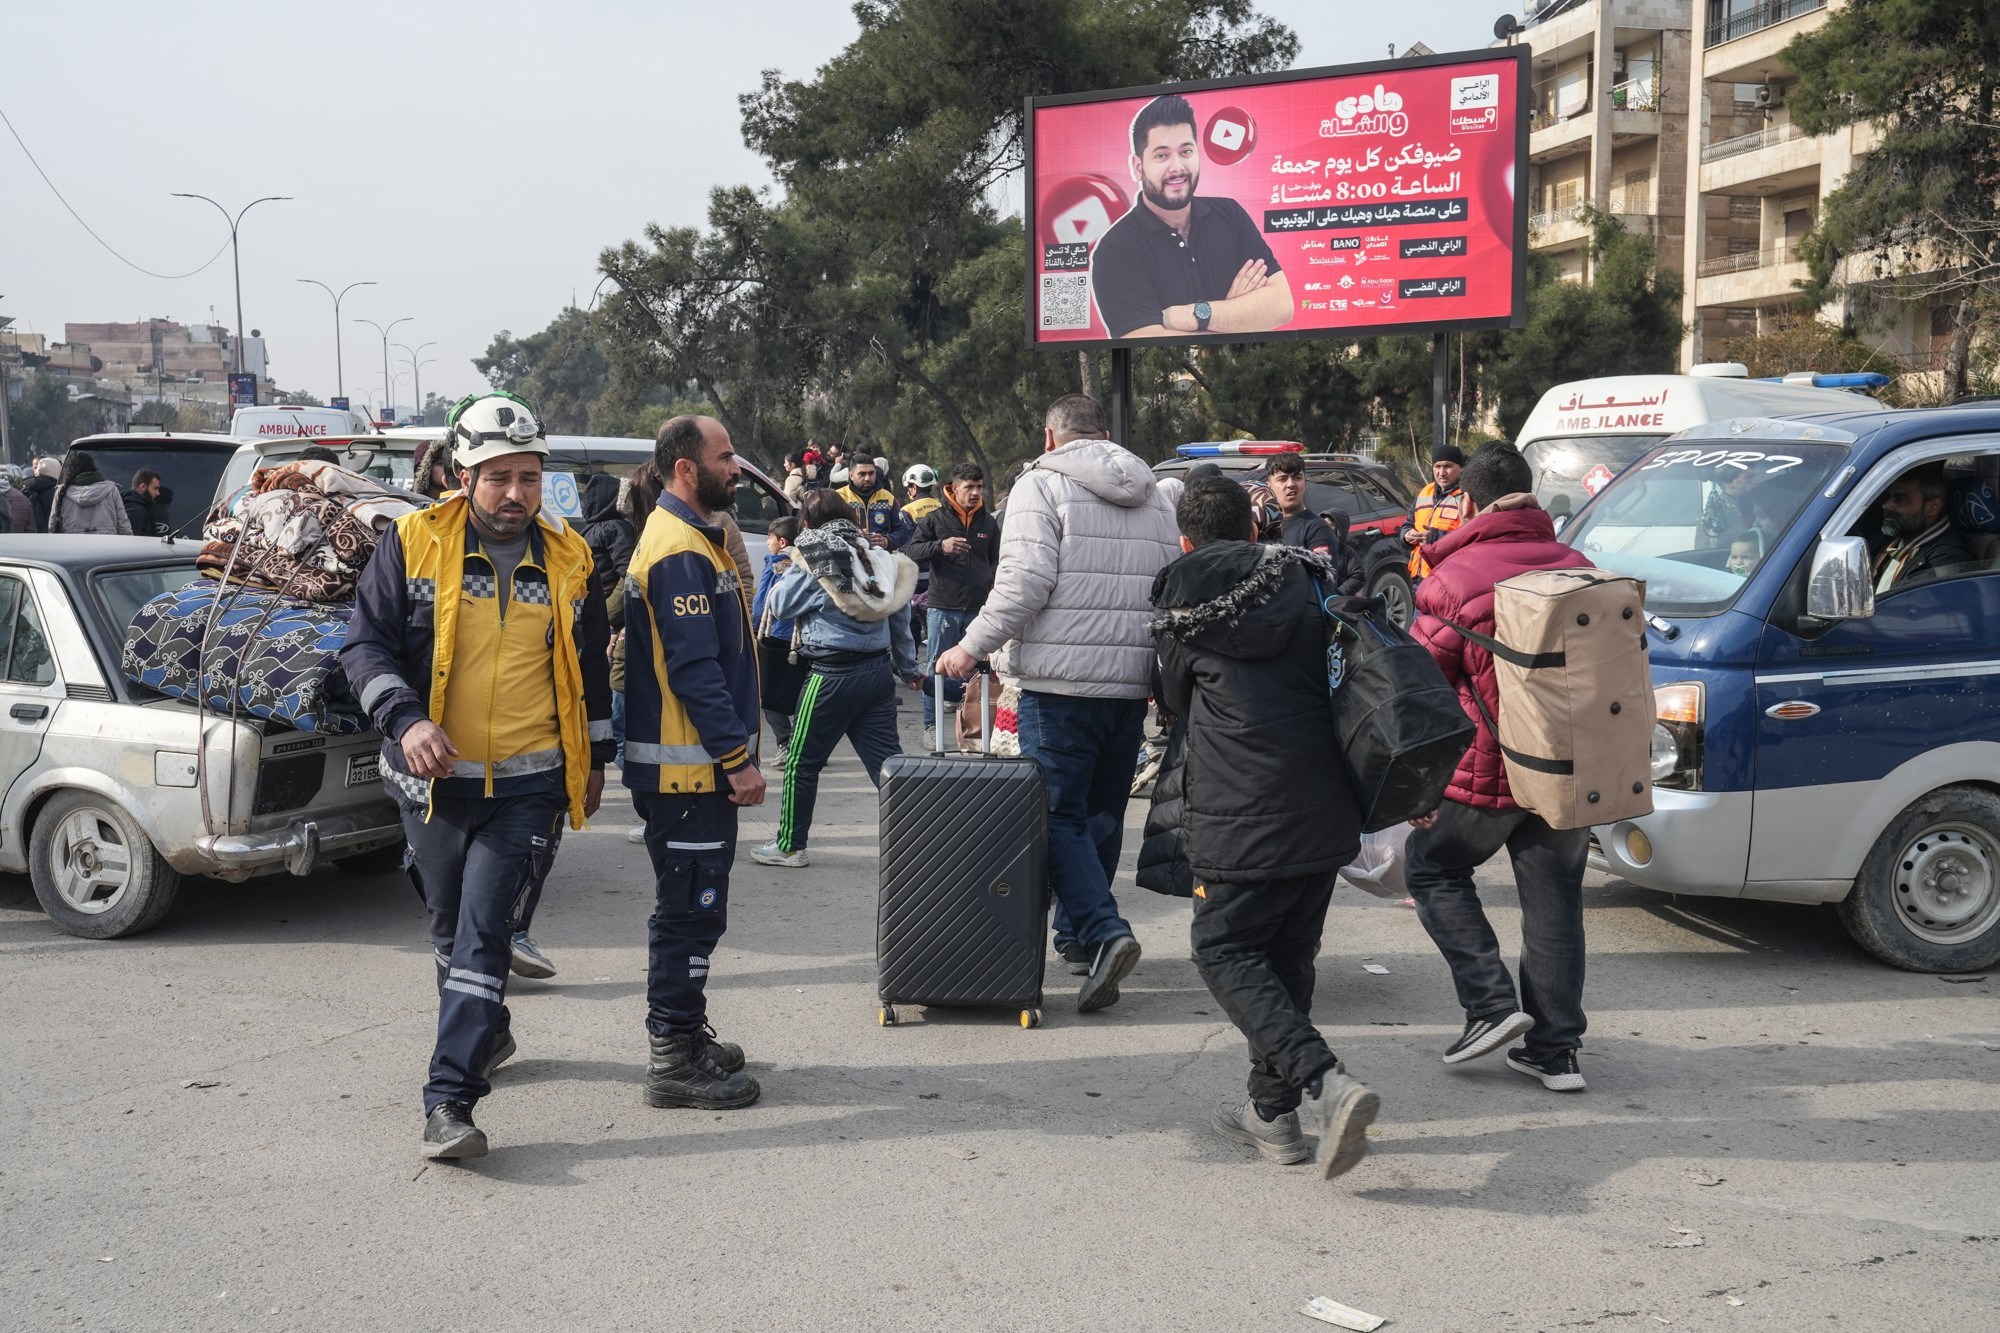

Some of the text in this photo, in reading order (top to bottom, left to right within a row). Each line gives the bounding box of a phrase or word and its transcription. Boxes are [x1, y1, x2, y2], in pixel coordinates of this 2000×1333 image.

[1271, 142, 1461, 178] ضيوفكن كل يوم جمعة
[1336, 181, 1387, 200] 8:00
[1391, 171, 1461, 195] الساعة
[1271, 201, 1461, 228] على منصة هيك وهيك على اليوتيوب
[1333, 239, 1359, 248] BANO
[1405, 239, 1461, 256] الراعي الذهبي
[1404, 280, 1460, 297] الراعي الفضي
[1558, 388, 1668, 412] اسعاف
[259, 424, 327, 436] AMBULANCE
[1640, 450, 1803, 474] SPORT
[673, 594, 711, 617] SCD
